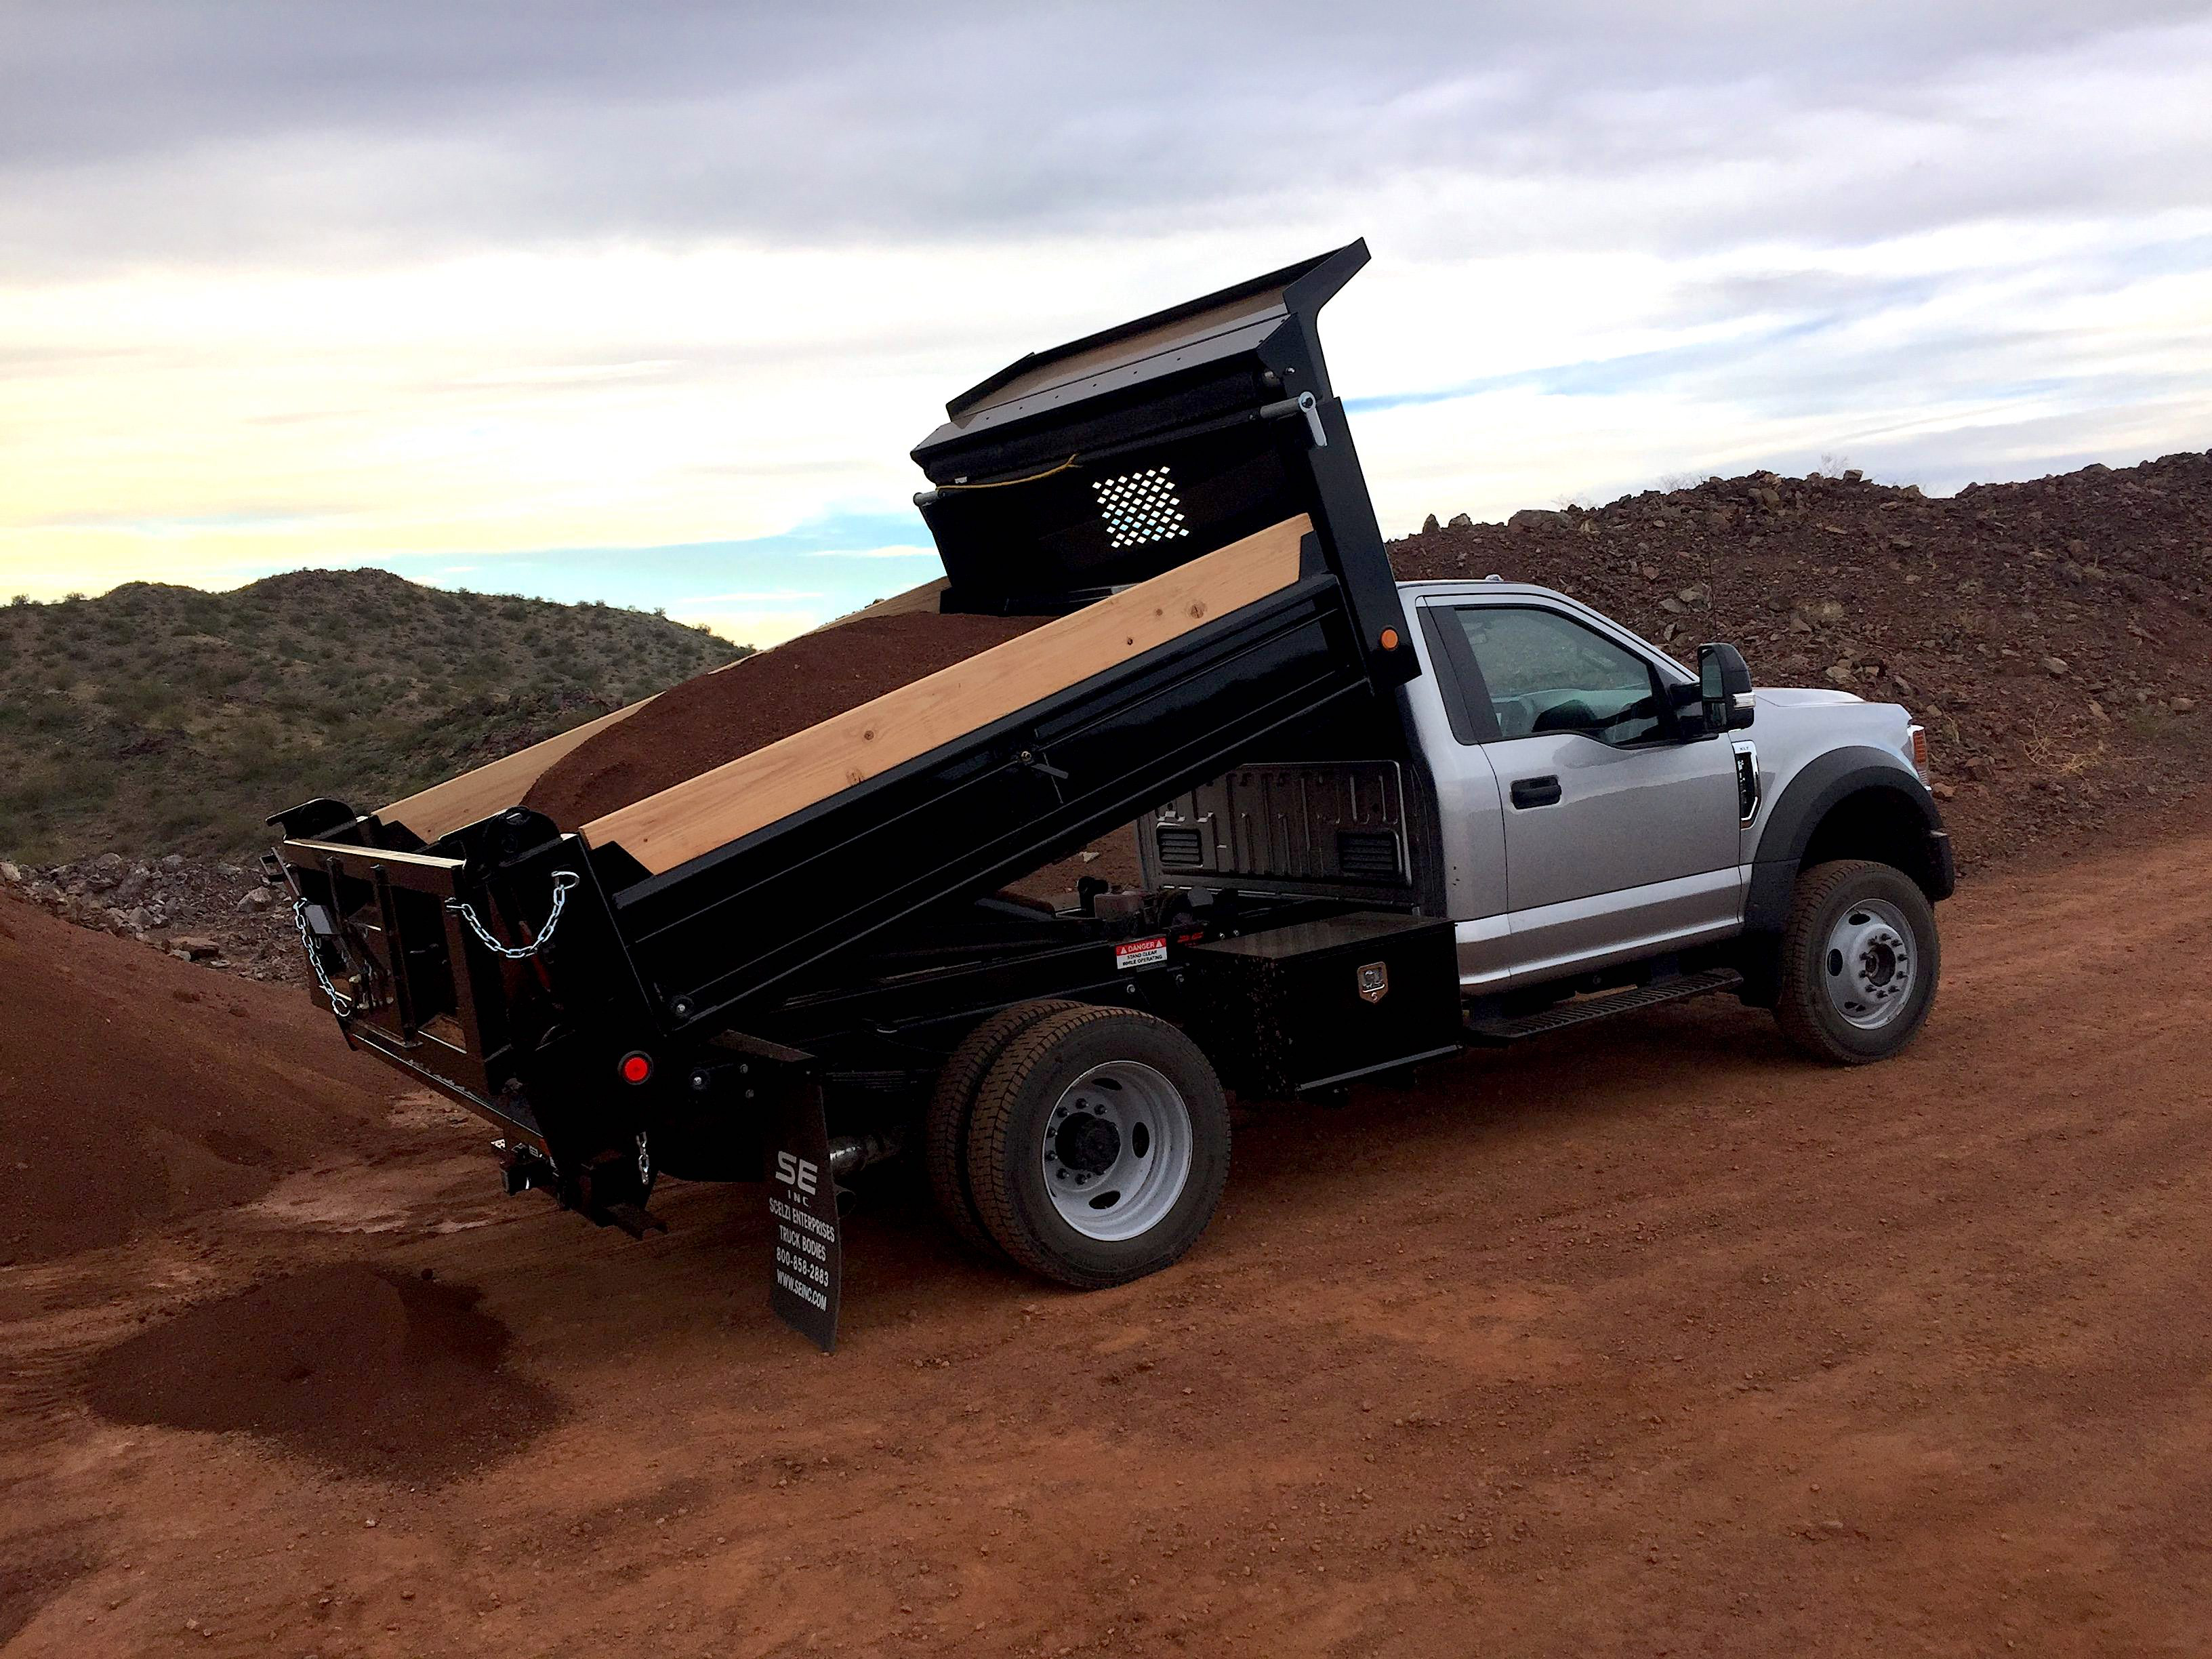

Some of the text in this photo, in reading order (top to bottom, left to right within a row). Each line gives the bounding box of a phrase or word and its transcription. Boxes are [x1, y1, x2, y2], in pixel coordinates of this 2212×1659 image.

[1128, 941, 1155, 952] DANGER
[1137, 954, 1163, 964] OPERATING
[775, 1151, 818, 1195] SE
[769, 1197, 835, 1244] SCELZI ENTERPRISES
[779, 1225, 826, 1262] TRUCK BODIES
[776, 1246, 829, 1287] 800-858-2883
[777, 1268, 827, 1312] WWW.SEINC.COM
